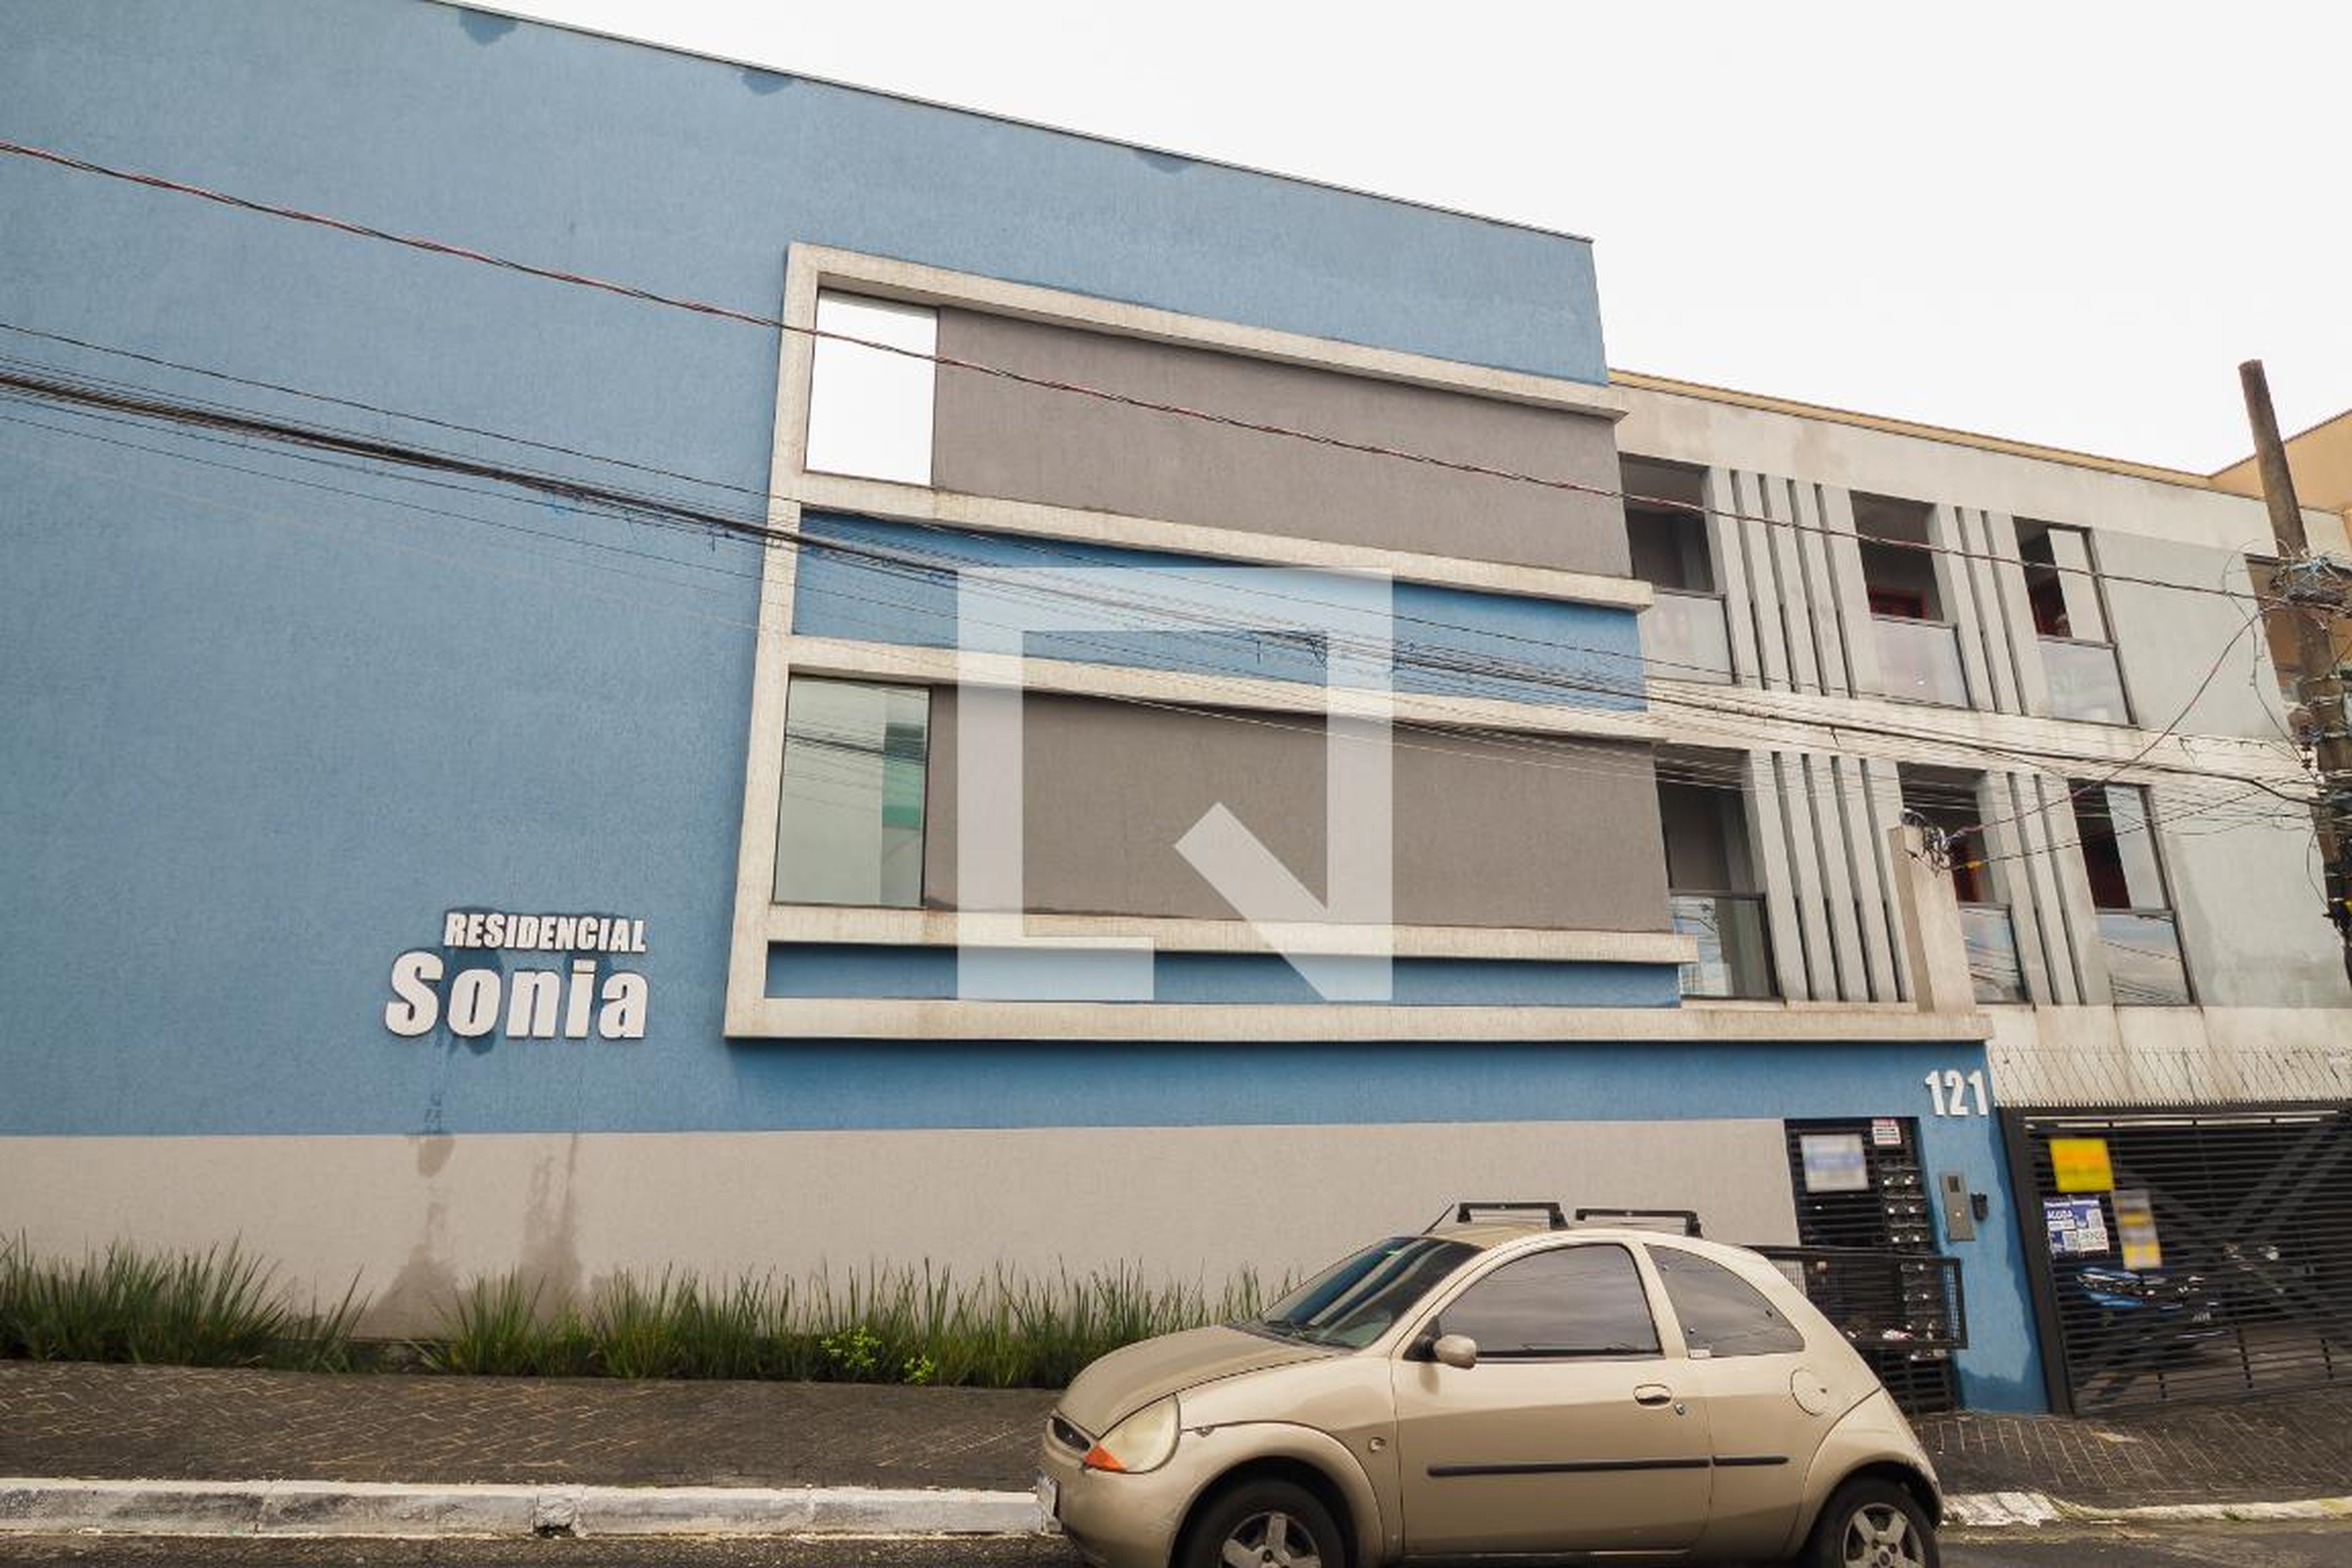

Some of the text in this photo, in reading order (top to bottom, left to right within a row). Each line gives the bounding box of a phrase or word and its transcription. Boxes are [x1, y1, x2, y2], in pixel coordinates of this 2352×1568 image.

[443, 913, 647, 952] RESIDENCIAL
[385, 951, 649, 1038] Sonia
[1924, 1069, 1989, 1115] 121
